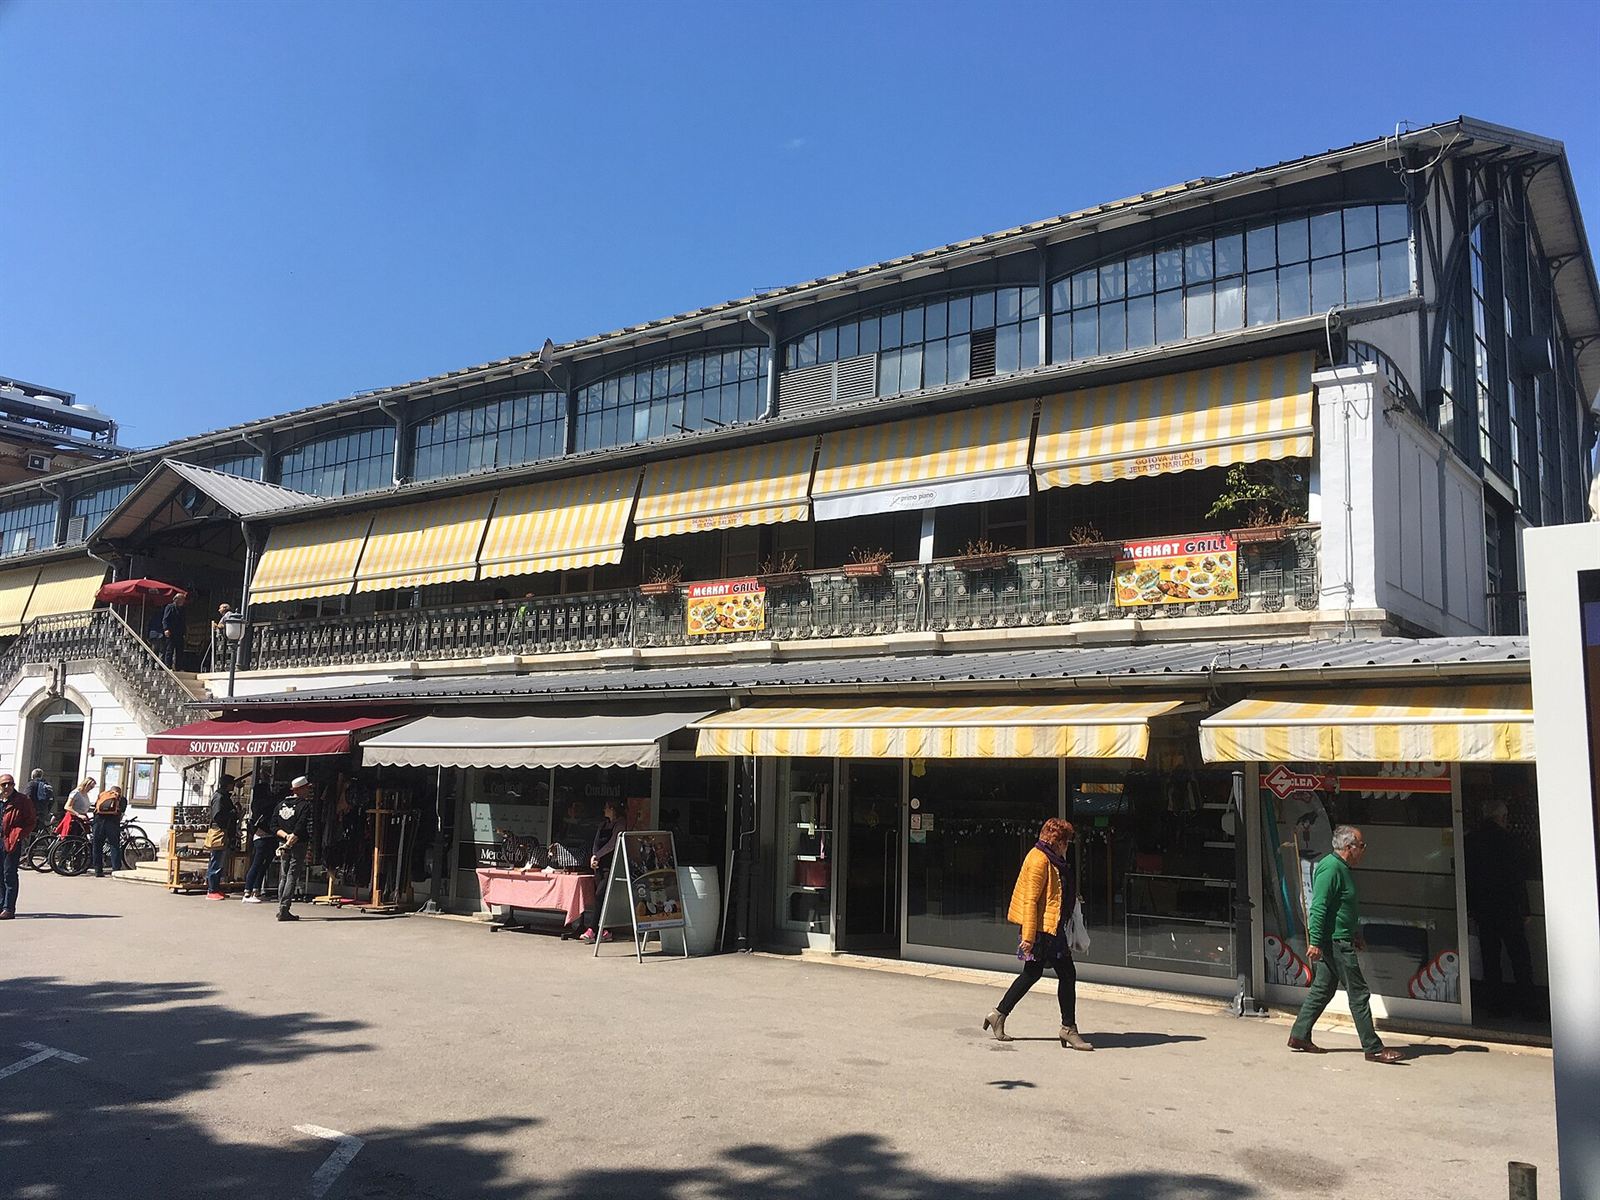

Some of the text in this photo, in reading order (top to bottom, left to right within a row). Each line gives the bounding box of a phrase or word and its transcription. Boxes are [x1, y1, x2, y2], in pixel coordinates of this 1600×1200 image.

[1129, 457, 1203, 474] JELA PO NARUDŽBI
[1135, 456, 1167, 466] GOTOVA
[1169, 453, 1189, 461] JELA
[901, 492, 934, 502] primo piano
[1122, 539, 1228, 559] MERKAT GRILL
[693, 581, 759, 597] MERKAT GRILL
[189, 741, 240, 753] SOUVENIRS
[246, 741, 267, 753] GIFT
[269, 740, 297, 753] SHOP
